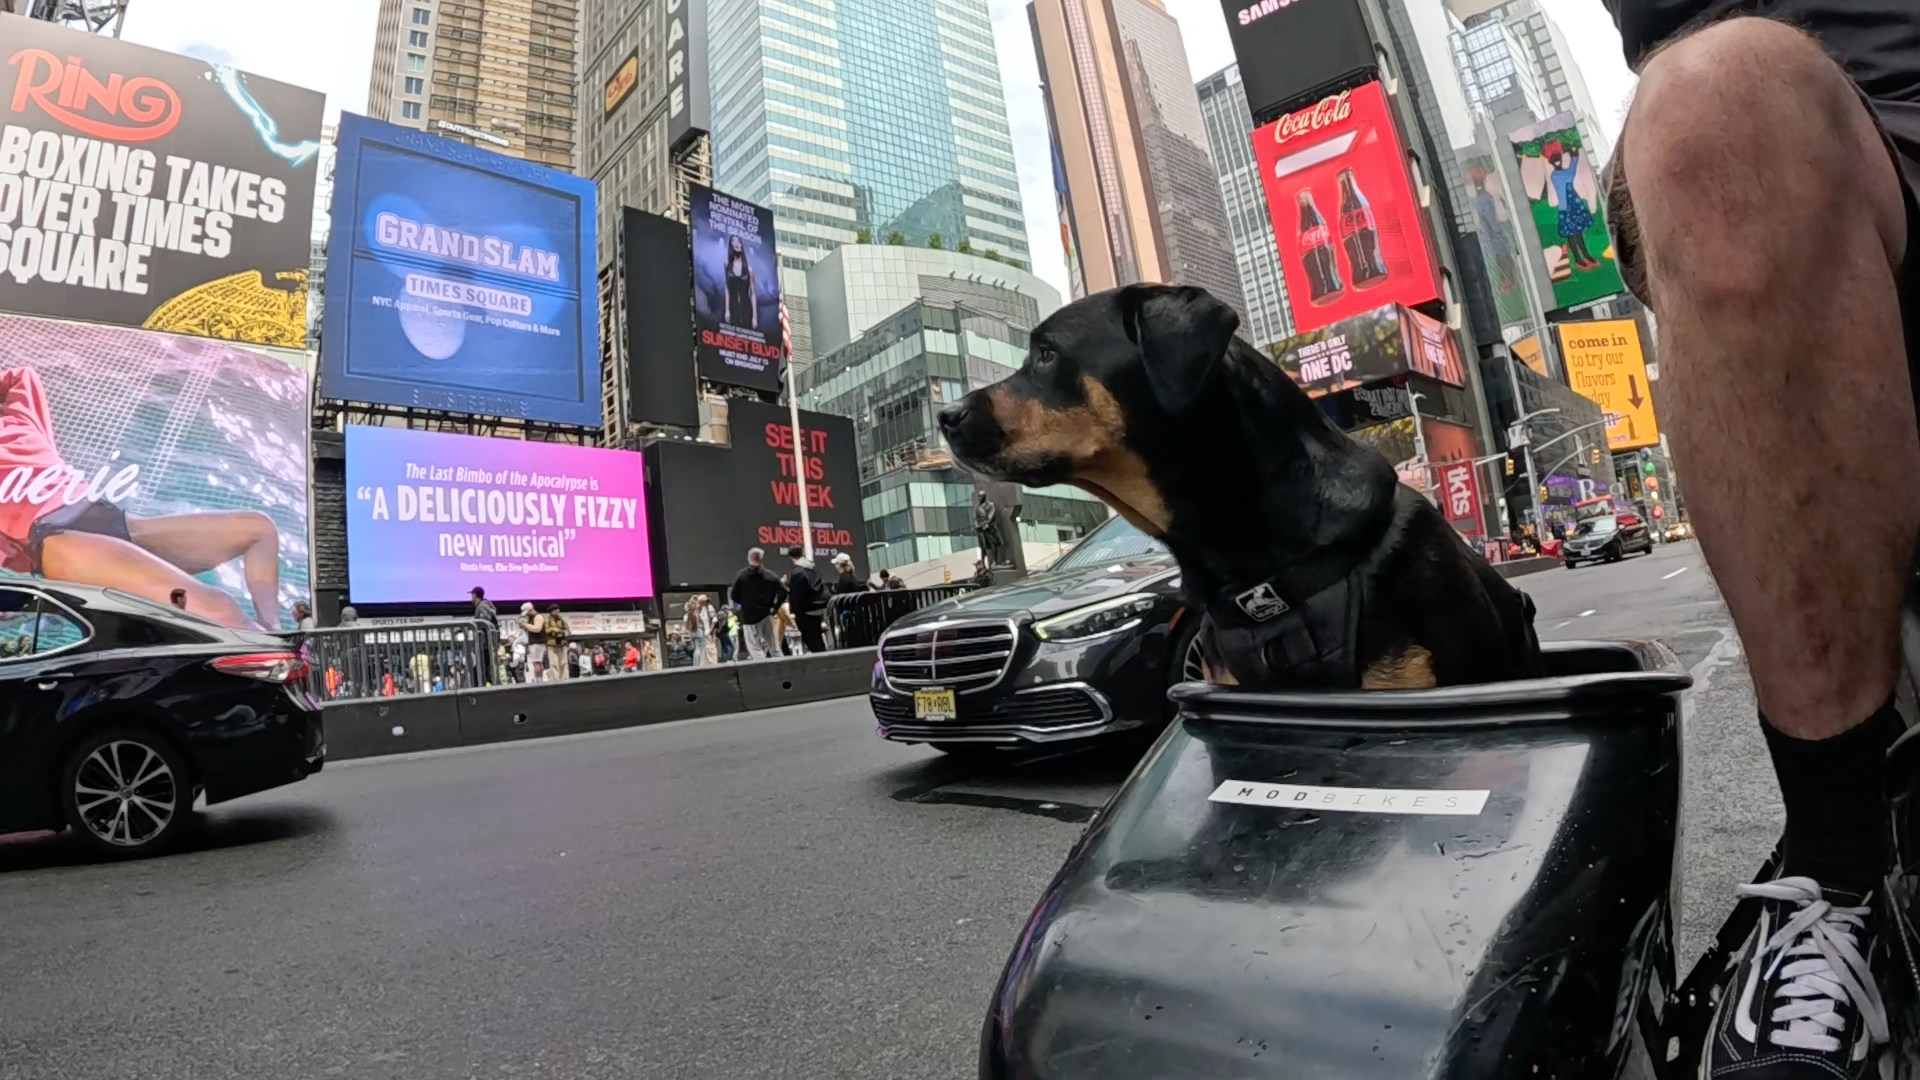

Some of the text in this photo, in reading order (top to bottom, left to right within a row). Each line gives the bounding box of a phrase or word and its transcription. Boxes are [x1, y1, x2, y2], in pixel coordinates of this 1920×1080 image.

[1238, 0, 1298, 25] SAM
[8, 48, 182, 142] RING
[1274, 87, 1352, 143] Coca-Cola
[0, 125, 286, 223] BOXING TAKES
[0, 173, 233, 258] OVER TIMES
[709, 201, 759, 225] NOMINATED
[712, 193, 755, 215] THE MOST
[708, 218, 762, 244] THE SEASON
[710, 210, 759, 234] REVIVAL OF
[376, 212, 560, 282] GRAND SLAM
[409, 277, 528, 312] TIMES SQUARE
[372, 295, 392, 307] NYC
[433, 305, 461, 320] Sports
[485, 315, 501, 328] Pop
[502, 318, 532, 332] Culture
[533, 323, 539, 333] &
[540, 324, 561, 336] More
[702, 330, 750, 352] SUNSET
[1327, 334, 1346, 348] ONLY
[1569, 333, 1628, 349] come in
[1301, 351, 1353, 383] ONE DC
[1571, 351, 1624, 370] to try our
[1575, 371, 1616, 388] flavors
[810, 430, 828, 454] IT
[0, 450, 139, 505] aerie
[405, 463, 600, 491] The Last Bimbo of the Apocalypse is
[1447, 465, 1471, 516] tkts
[397, 484, 567, 526] DELICIOUSLY
[573, 494, 638, 529] FIZZY
[438, 531, 483, 557] new
[817, 529, 853, 546] BLVD.
